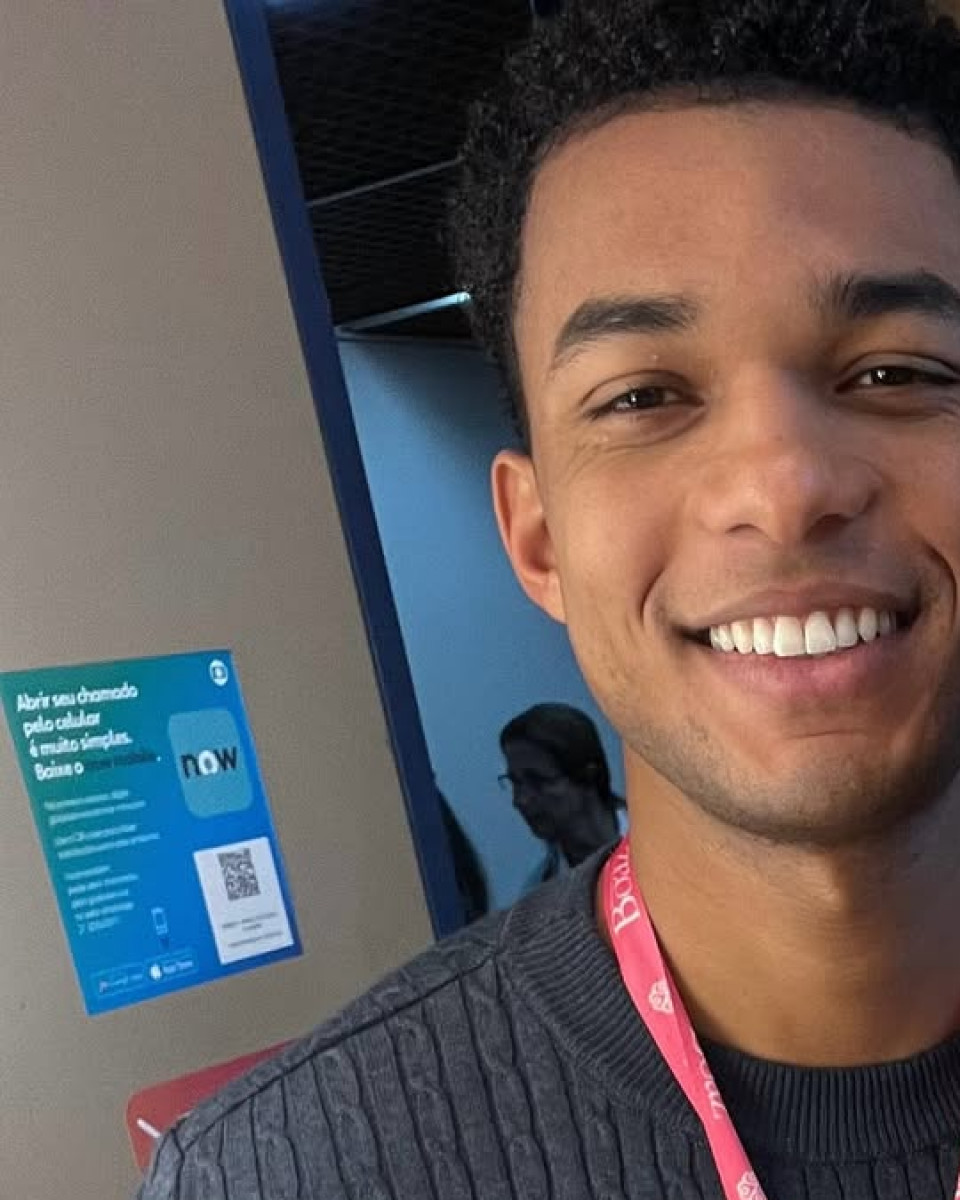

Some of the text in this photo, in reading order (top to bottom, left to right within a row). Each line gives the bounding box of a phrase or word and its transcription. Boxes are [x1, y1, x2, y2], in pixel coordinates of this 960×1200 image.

[16, 681, 139, 712] Abrir seu chamado
[22, 709, 101, 738] pelo celular
[40, 736, 79, 756] muito
[34, 760, 74, 781] Baixe
[74, 761, 85, 776] o
[180, 747, 238, 779] now
